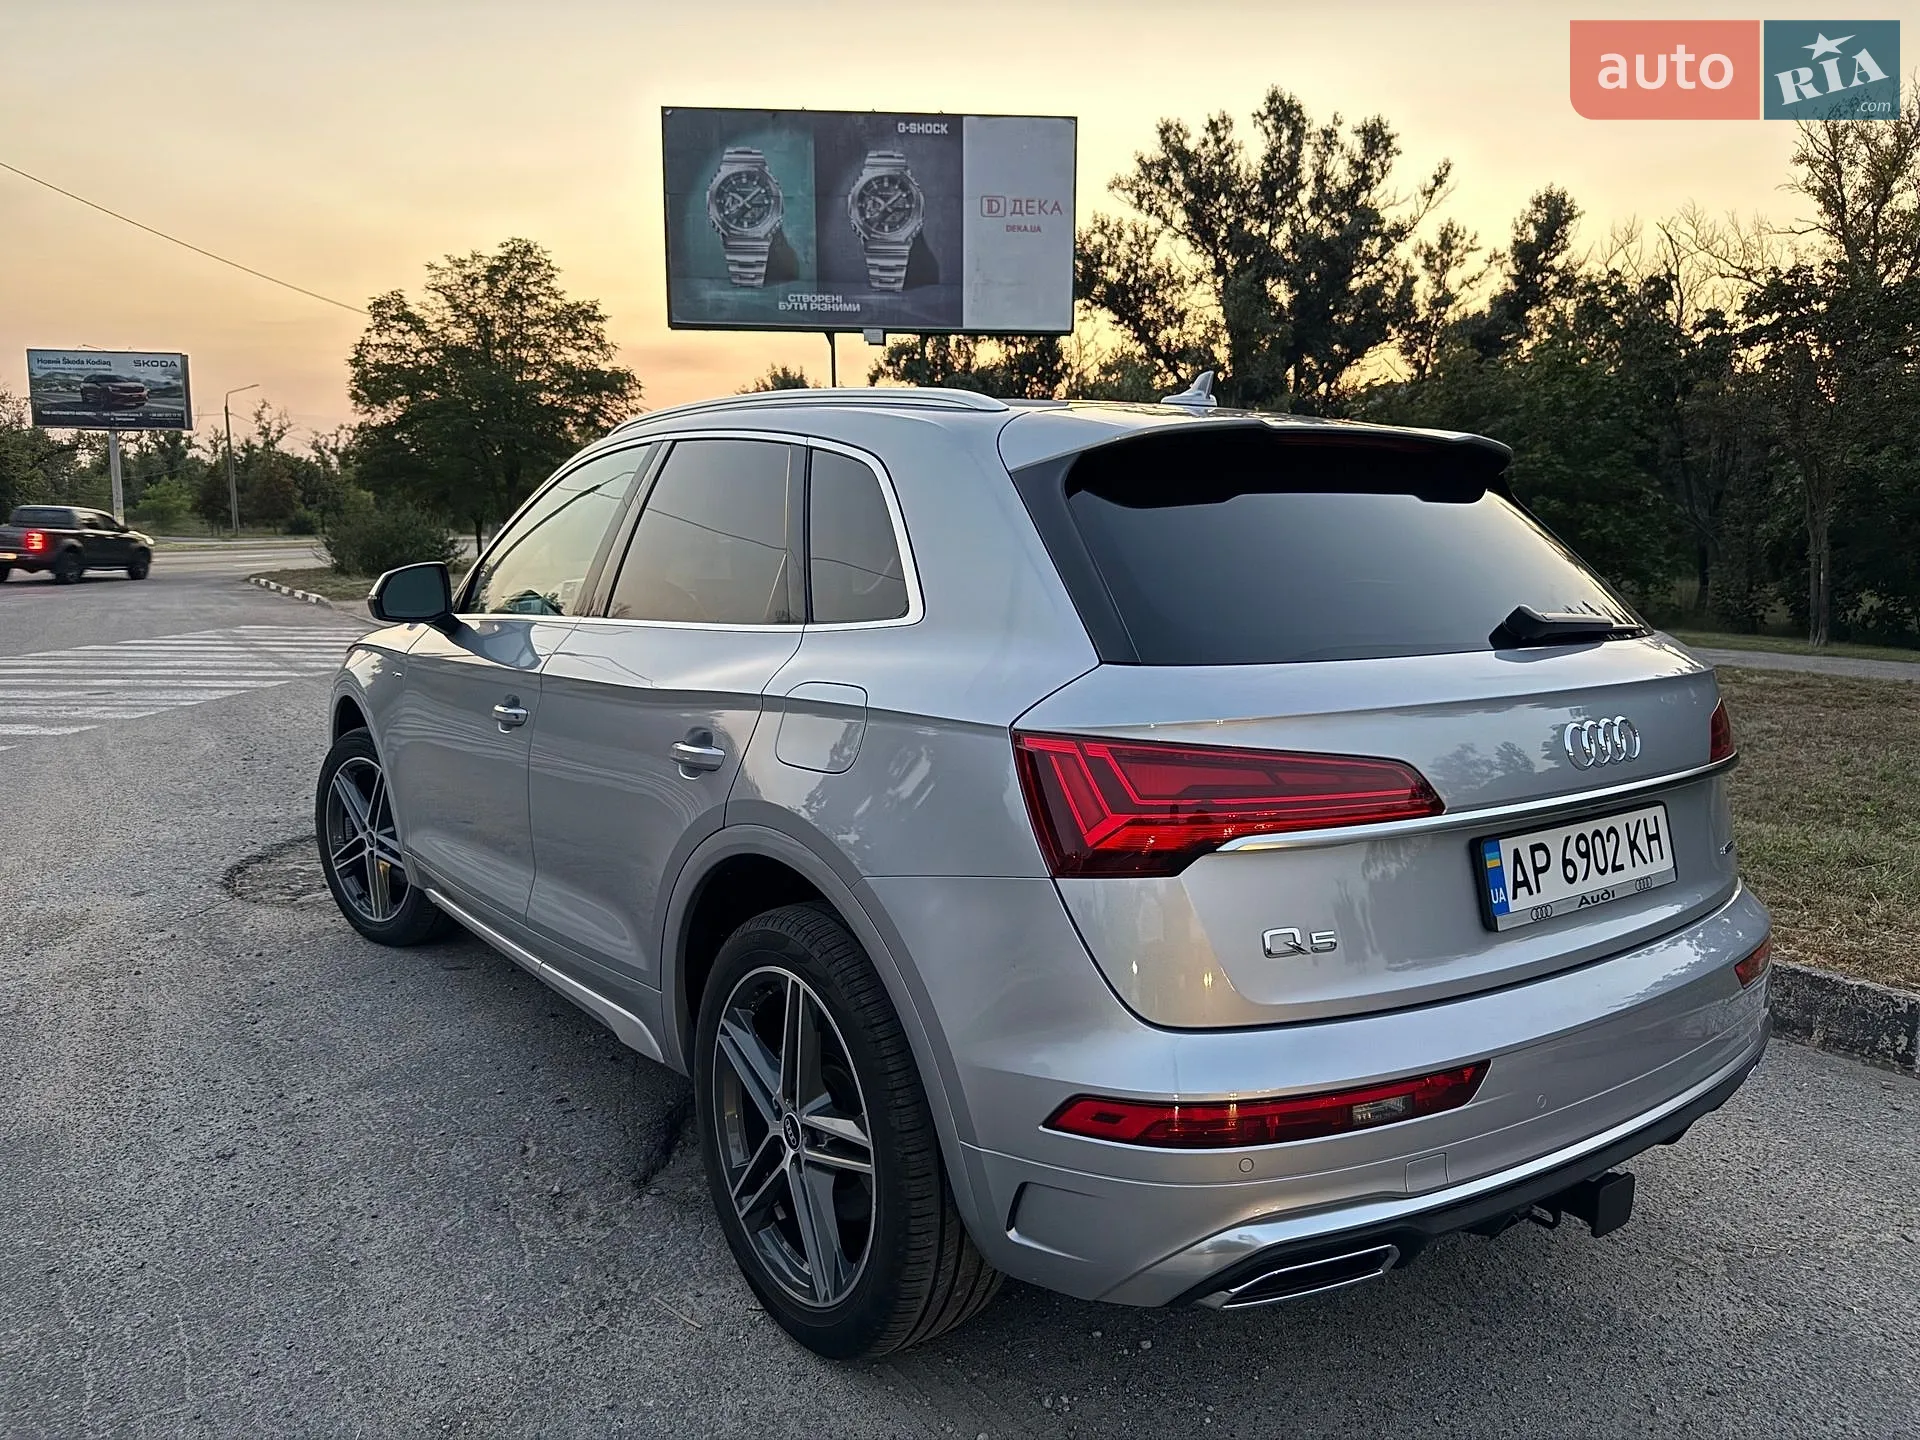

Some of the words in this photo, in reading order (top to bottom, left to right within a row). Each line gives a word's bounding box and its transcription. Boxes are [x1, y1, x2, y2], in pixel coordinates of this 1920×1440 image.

[897, 121, 949, 135] G-SHOCK
[1010, 198, 1063, 217] ДЕКА
[1005, 224, 1042, 233] DEKA.UA
[787, 293, 843, 304] СТВОРЕНІ
[778, 302, 808, 311] БУТИ
[810, 302, 861, 313] РІЗНИМИ
[1511, 842, 1551, 900] AP
[1561, 826, 1625, 885] 6902
[1625, 815, 1664, 868] KH
[1490, 887, 1506, 904] UA
[1577, 889, 1616, 908] Audi
